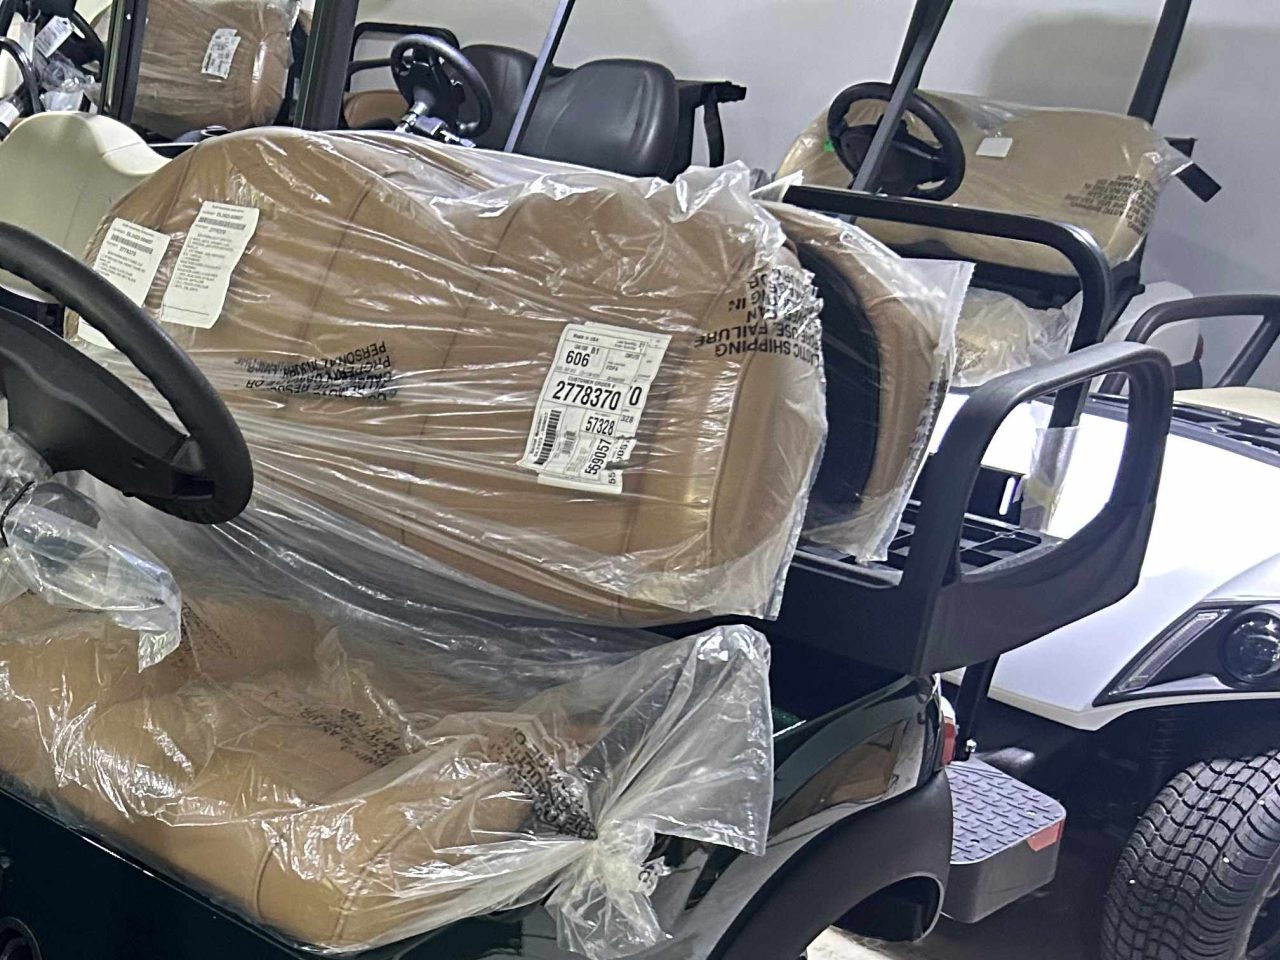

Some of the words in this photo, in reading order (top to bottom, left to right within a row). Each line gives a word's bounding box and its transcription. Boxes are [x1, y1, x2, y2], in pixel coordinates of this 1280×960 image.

[694, 322, 769, 348] FAILURE
[714, 338, 791, 357] SHIPPING
[565, 350, 591, 367] 606
[552, 380, 622, 411] 2778370
[585, 416, 616, 436] 57328
